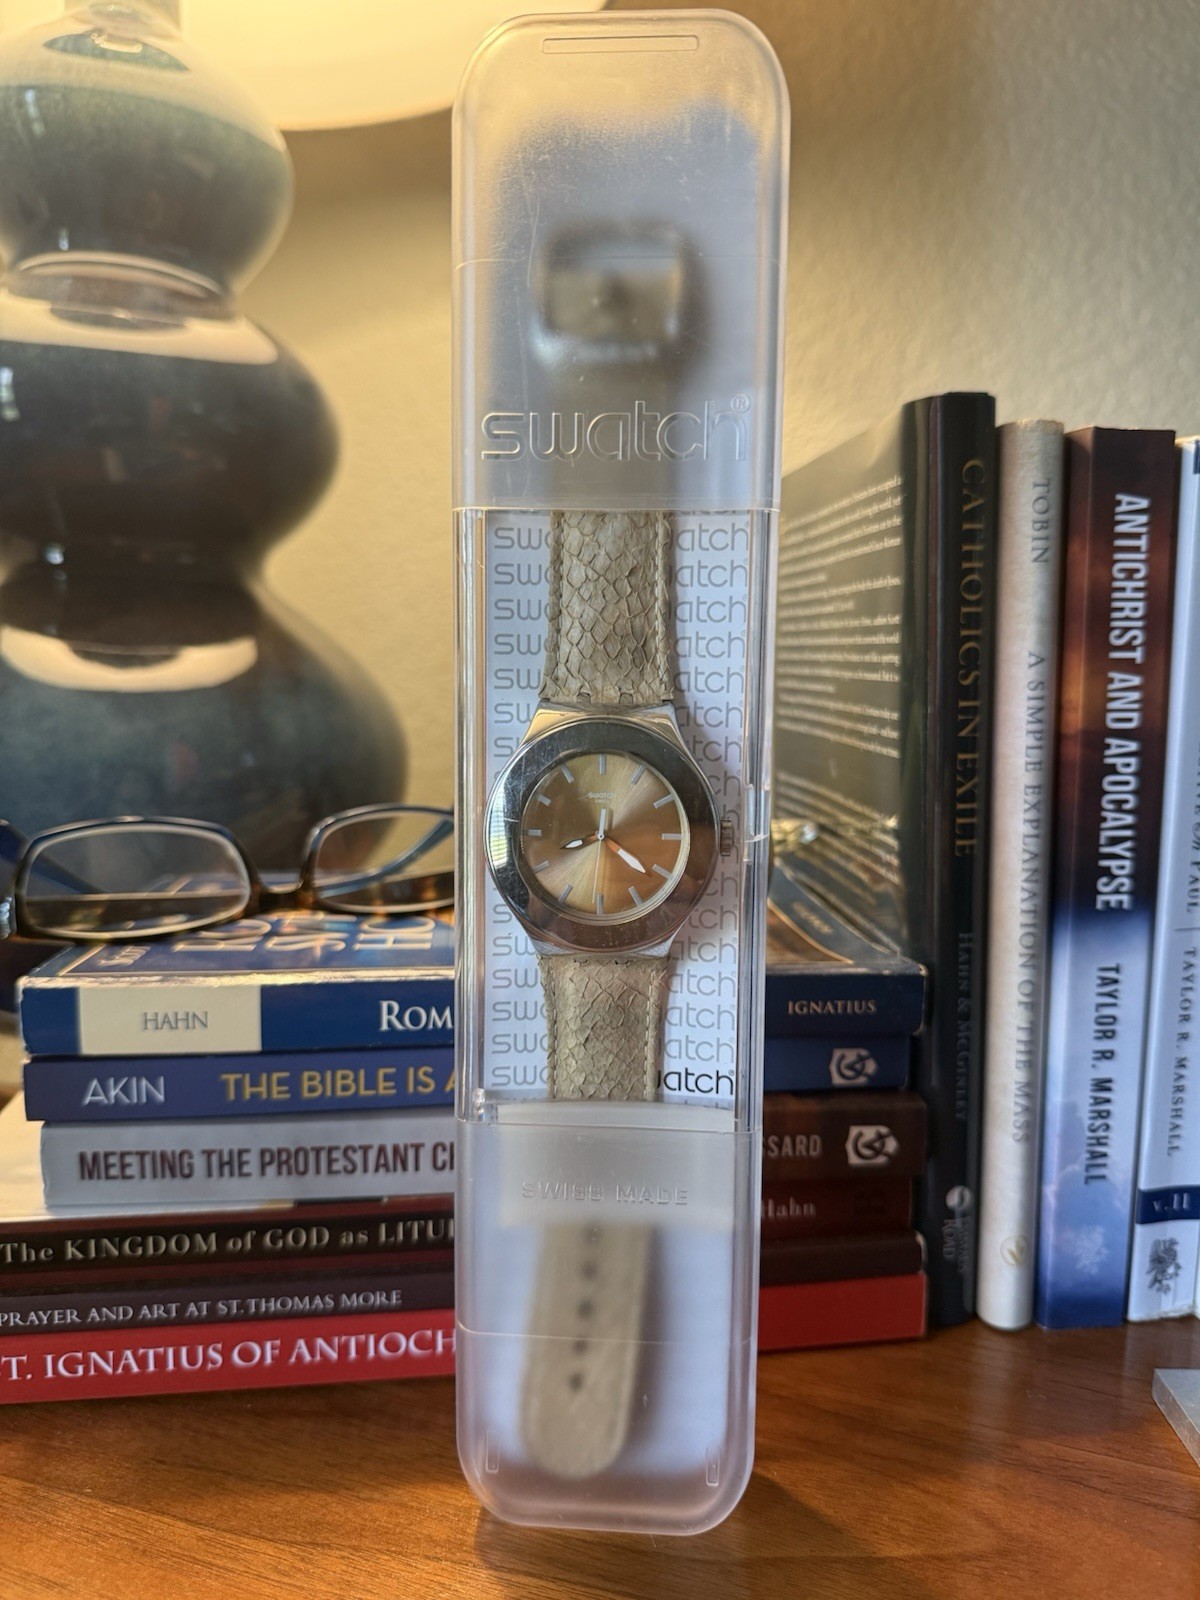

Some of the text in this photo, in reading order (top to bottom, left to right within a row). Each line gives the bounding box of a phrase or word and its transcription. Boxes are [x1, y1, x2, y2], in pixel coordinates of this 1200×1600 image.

[1031, 477, 1051, 564] TOBIN
[955, 457, 986, 857] CATHOLICS IN EXILE
[1096, 492, 1150, 912] ANTICHRIST AND APOCALYPSE
[1012, 651, 1047, 1145] A SIMPLE EXPLANATION OF THE MASS
[143, 1011, 209, 1031] HAHN
[380, 1001, 455, 1032] ROM
[787, 1000, 877, 1016] IGNATIUS
[1166, 947, 1197, 1158] TAYLOR R. MARSHALL
[83, 1075, 165, 1106] AKIN
[221, 1071, 291, 1101] THE
[302, 1067, 397, 1099] BIBLE
[408, 1065, 435, 1094] IS
[1084, 963, 1120, 1186] TAYLOR R. MARSHALL
[79, 1149, 195, 1181] MEETING
[203, 1147, 252, 1178] THE
[260, 1142, 425, 1177] PROTESTANT
[764, 1135, 823, 1159] SARD
[615, 1185, 688, 1206] MADE
[0, 1242, 54, 1264] The
[64, 1231, 217, 1261] KINGDOM
[226, 1229, 256, 1252] of
[263, 1225, 330, 1250] GOD
[339, 1229, 369, 1247] as
[942, 1218, 957, 1260] ROAD
[87, 1304, 134, 1324] AND
[138, 1302, 181, 1320] ART
[185, 1300, 212, 1317] AT
[248, 1294, 335, 1316] THOMAS
[340, 1289, 402, 1310] MORE
[0, 1329, 456, 1381] T. IGNATIUS OF ANTIOCH
